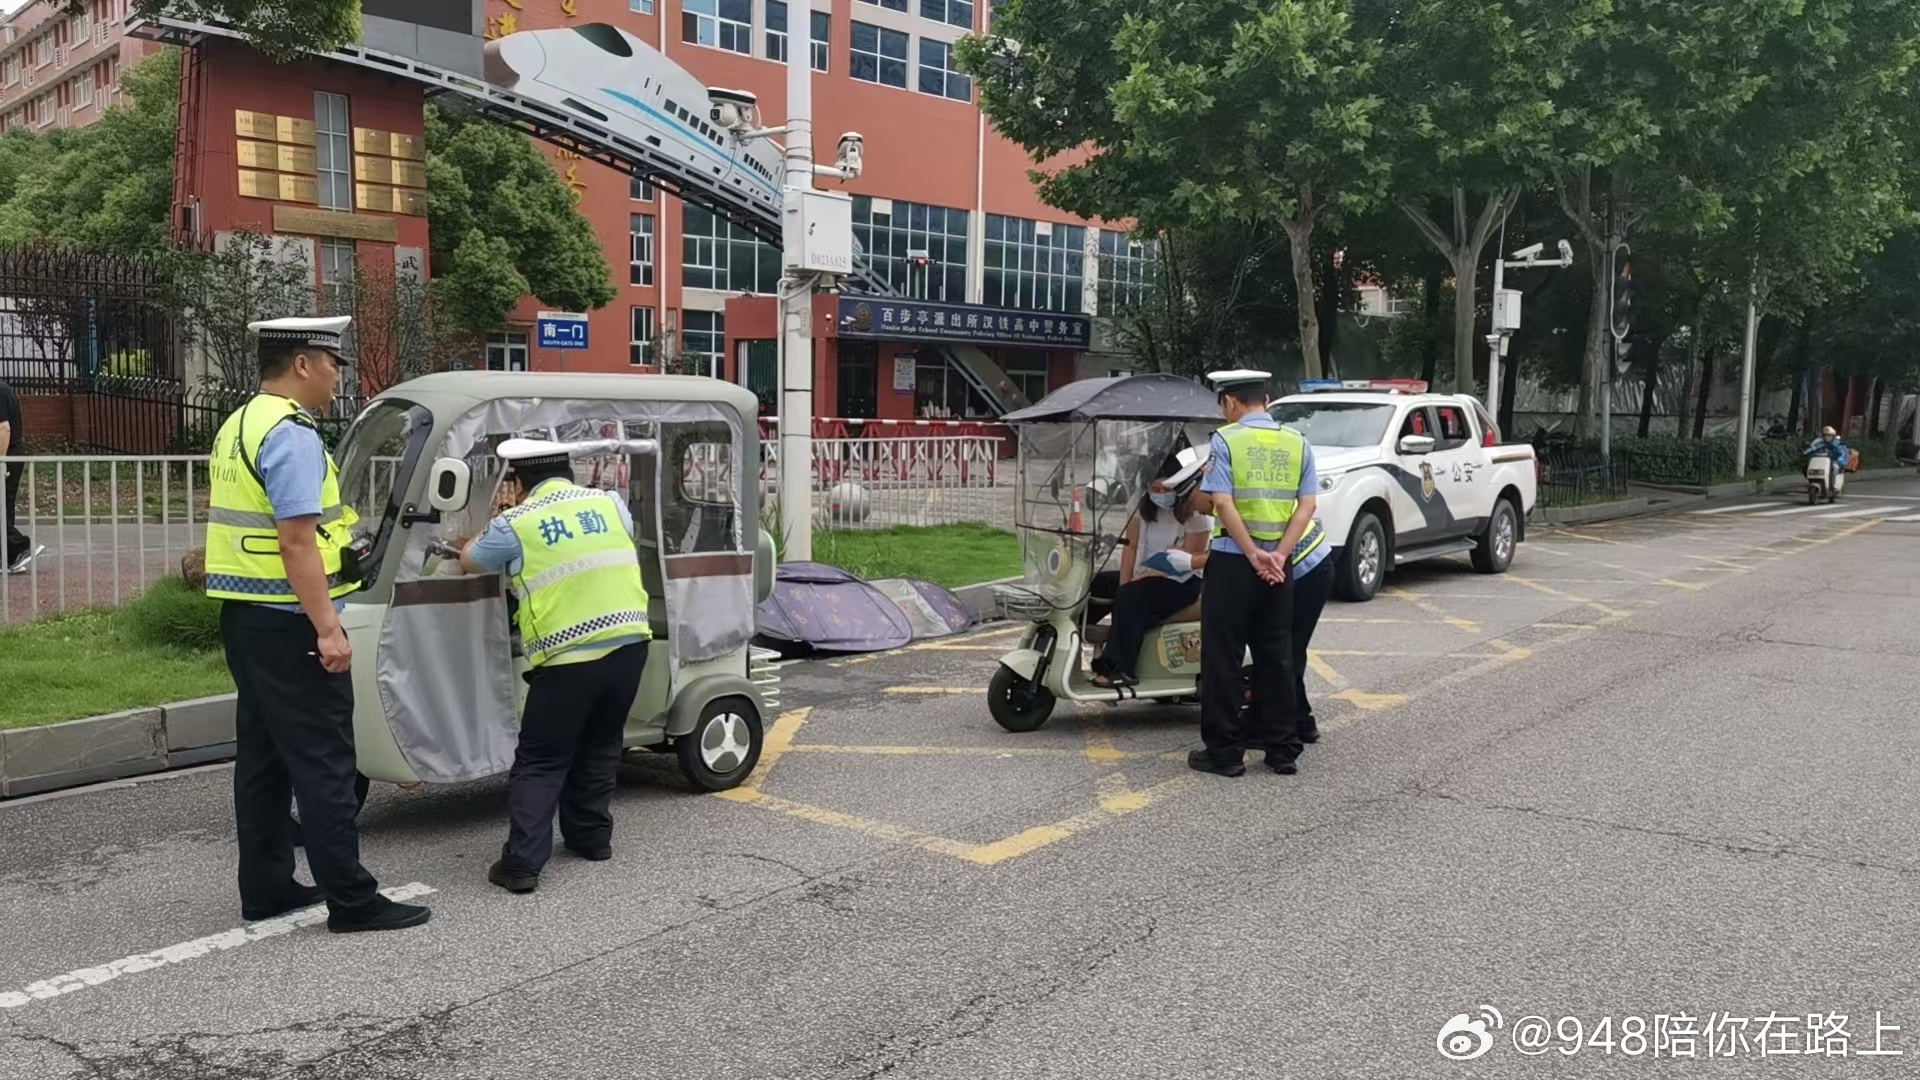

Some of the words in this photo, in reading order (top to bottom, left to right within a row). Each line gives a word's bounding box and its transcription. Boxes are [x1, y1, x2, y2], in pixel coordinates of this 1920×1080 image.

[543, 322, 583, 339] 南一门
[881, 307, 1083, 335] 百步亭派出所汉铁高中警务室
[1246, 446, 1290, 471] 警察
[1246, 471, 1292, 483] POLICE
[1452, 461, 1473, 483] 公安
[538, 509, 608, 546] 执勤
